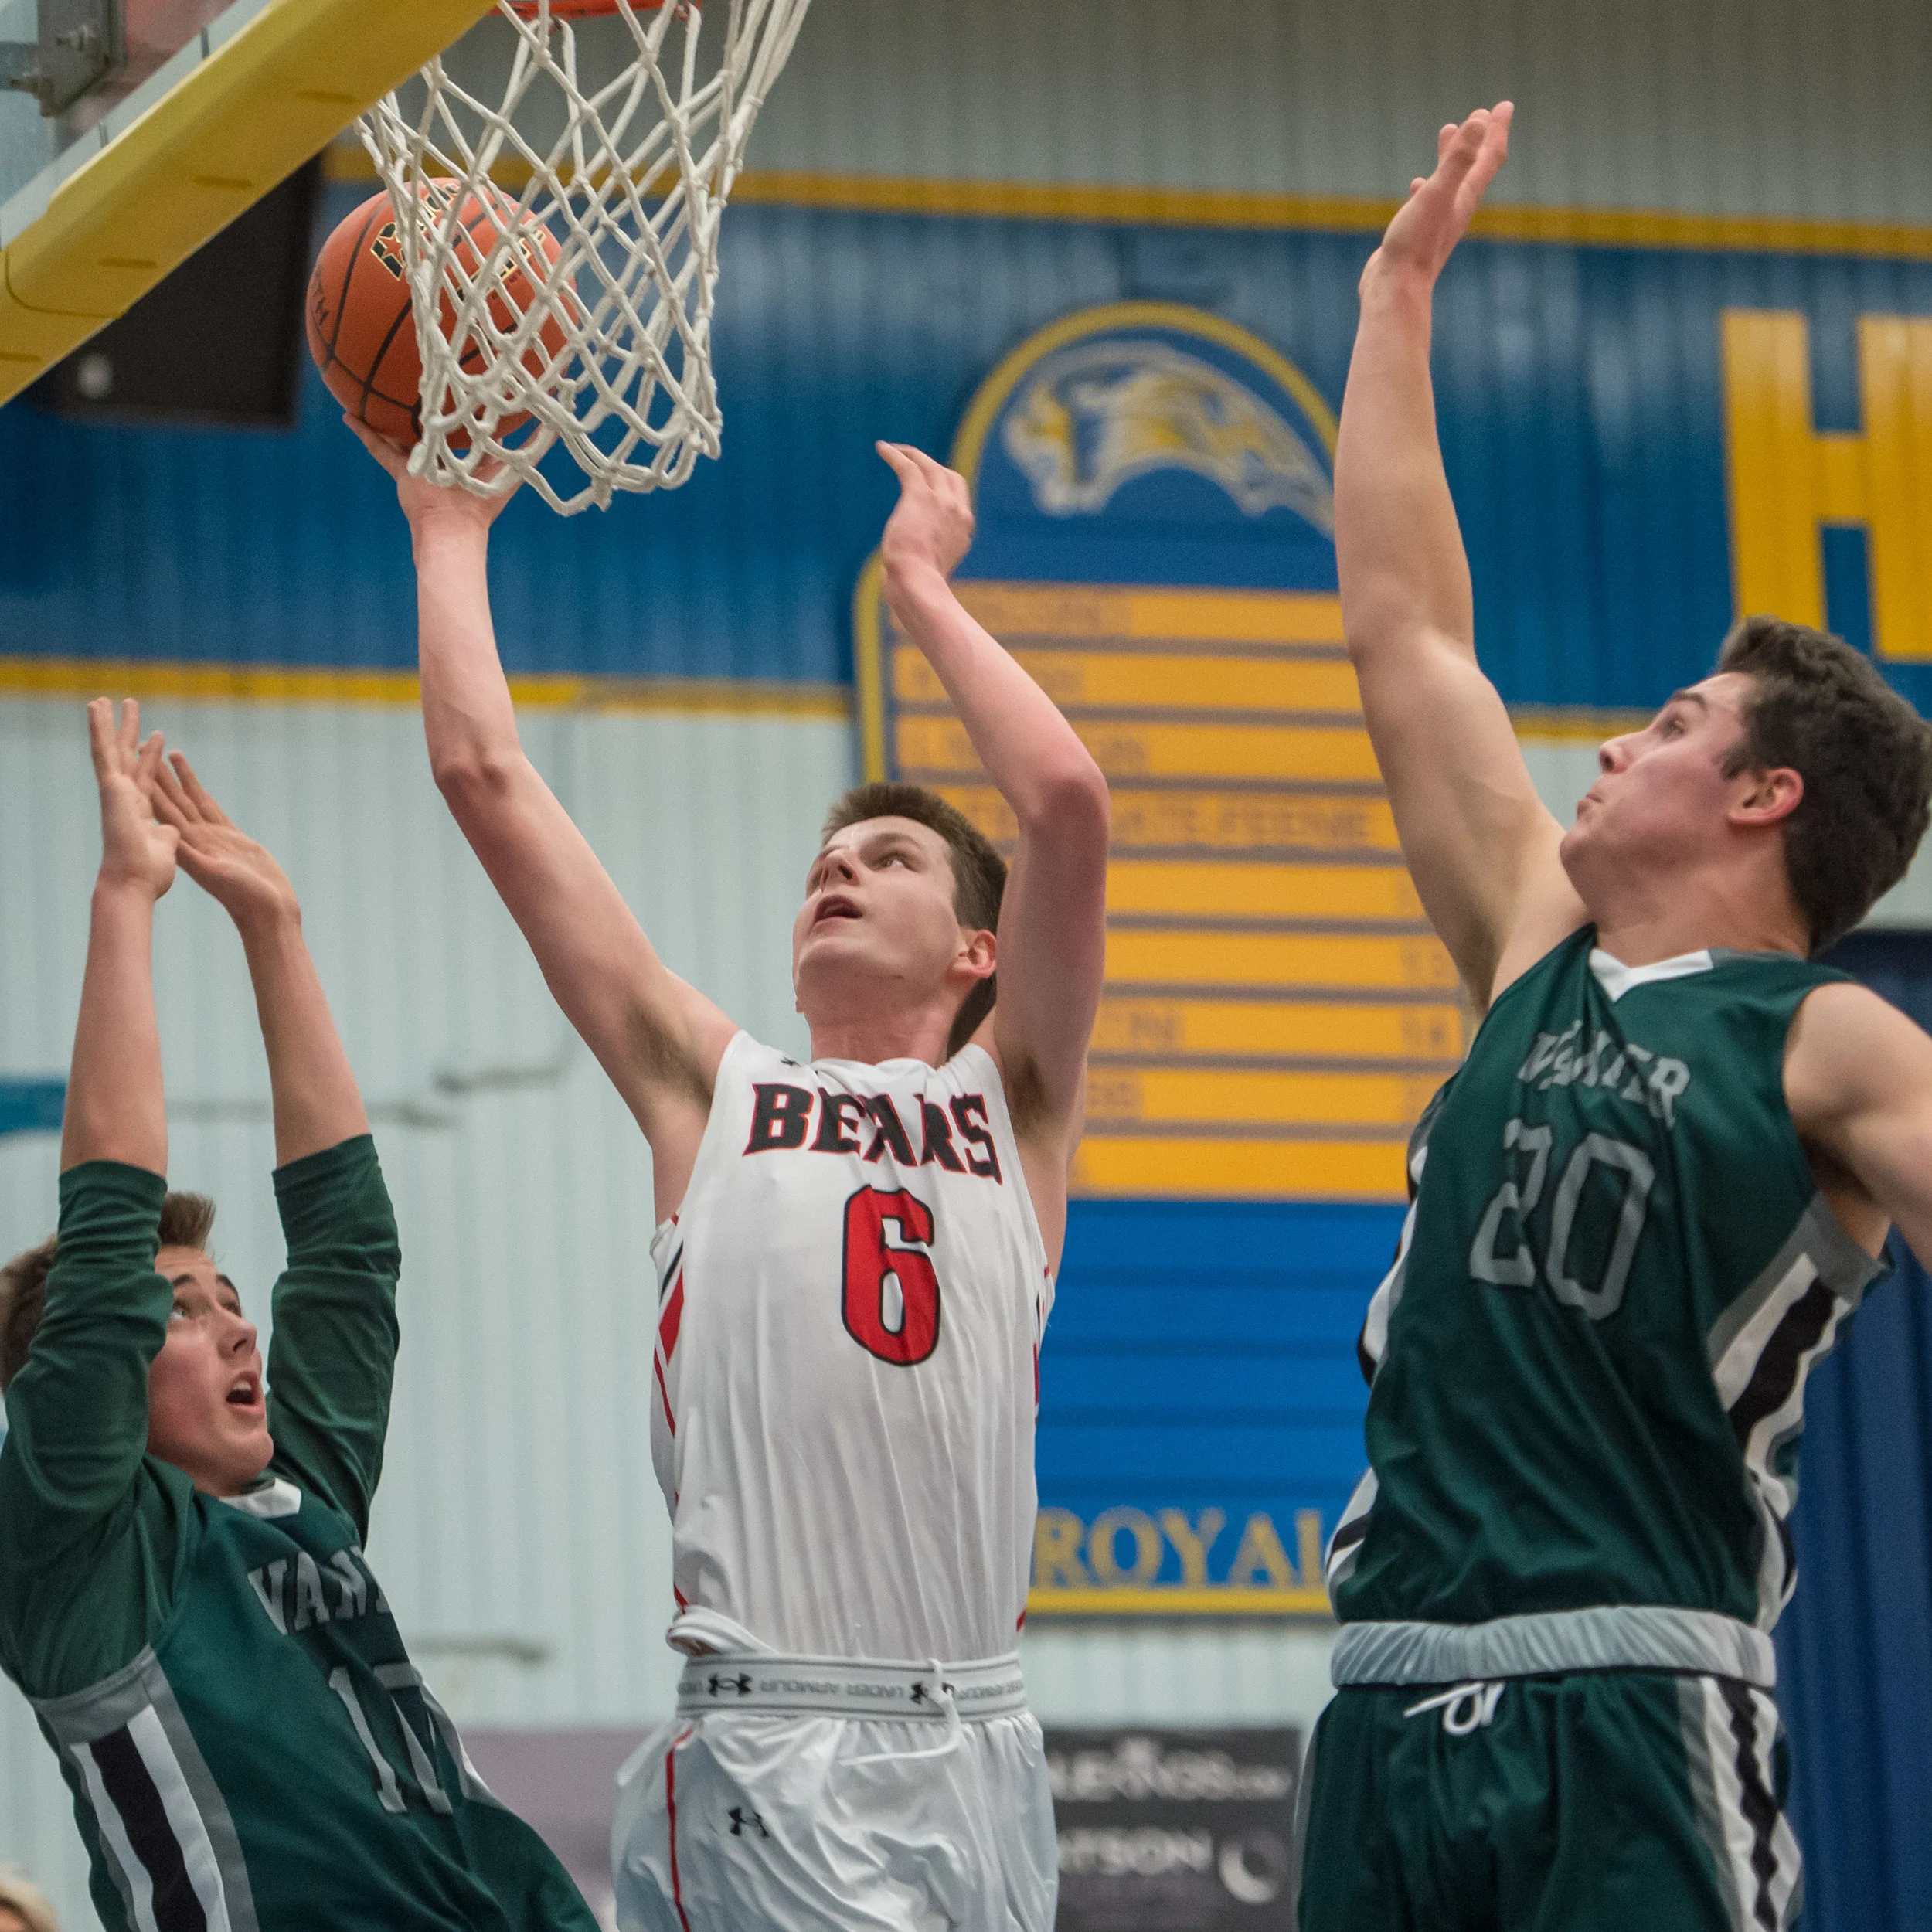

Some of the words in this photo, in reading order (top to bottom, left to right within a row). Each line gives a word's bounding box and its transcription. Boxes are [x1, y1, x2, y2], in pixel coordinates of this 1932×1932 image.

[742, 1082, 1002, 1185] BEARS
[1470, 1117, 1655, 1321] 20
[841, 1184, 941, 1366] 6
